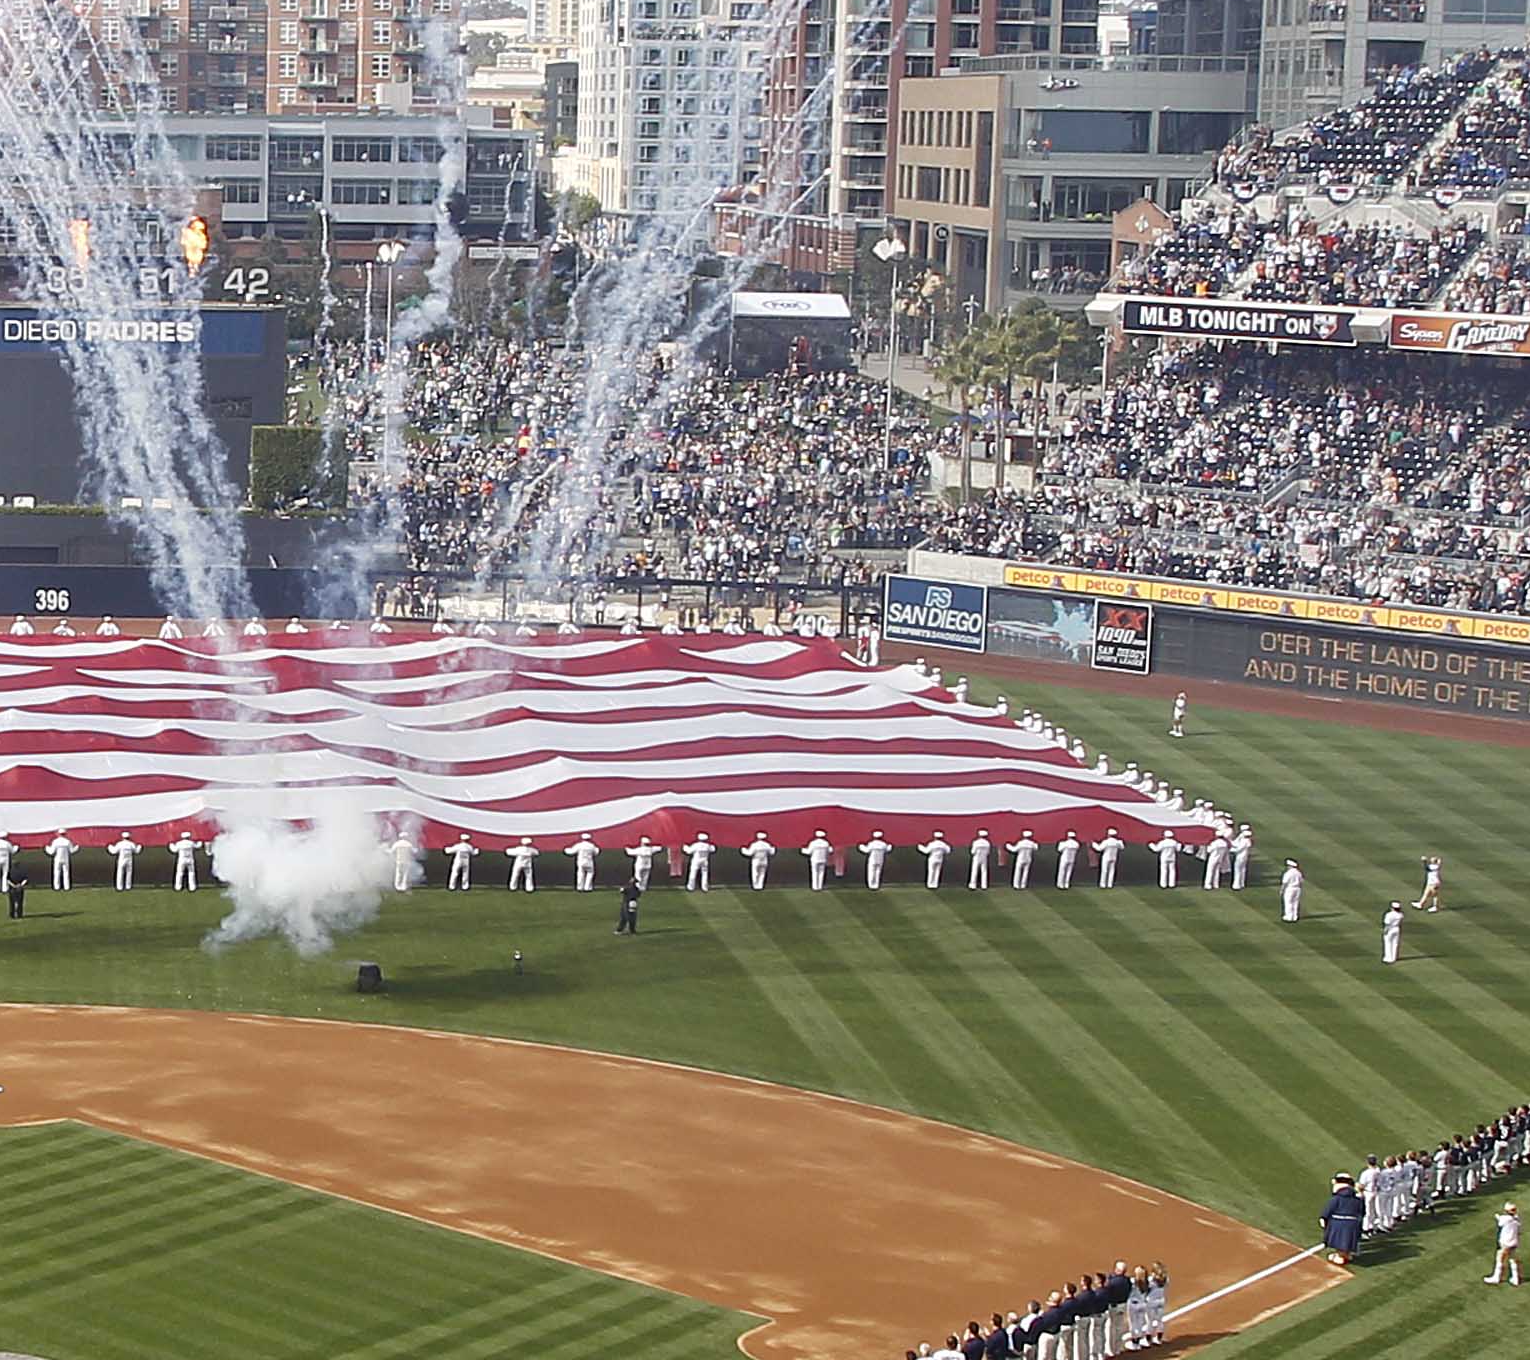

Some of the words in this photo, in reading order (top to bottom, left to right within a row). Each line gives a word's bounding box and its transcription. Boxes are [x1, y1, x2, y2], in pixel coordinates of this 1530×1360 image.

[223, 268, 270, 294] 42
[1140, 305, 1182, 328] MLB
[1187, 308, 1280, 333] TONIGHT
[1285, 318, 1311, 335] ON
[4, 320, 75, 340] DIEGO
[85, 321, 194, 342] PADRES
[1013, 570, 1050, 585] petco
[1085, 578, 1124, 593] petco
[35, 589, 69, 611] 396
[1160, 587, 1200, 602] petco
[1237, 595, 1278, 611] petco
[888, 603, 929, 623] SAN
[930, 607, 982, 632] DIEGO
[1316, 604, 1359, 620] petco
[1399, 614, 1442, 630] petco
[1483, 622, 1529, 639] petco
[1097, 626, 1136, 644] 1090
[1260, 631, 1311, 655] O'ER
[1318, 638, 1363, 663] THE
[1370, 645, 1438, 672] LAND
[1445, 653, 1477, 676] OF
[1244, 659, 1297, 683] AND
[1304, 665, 1348, 690] THE
[1355, 671, 1428, 699] HOME
[1433, 681, 1466, 703] OF
[1473, 686, 1520, 712] THE
